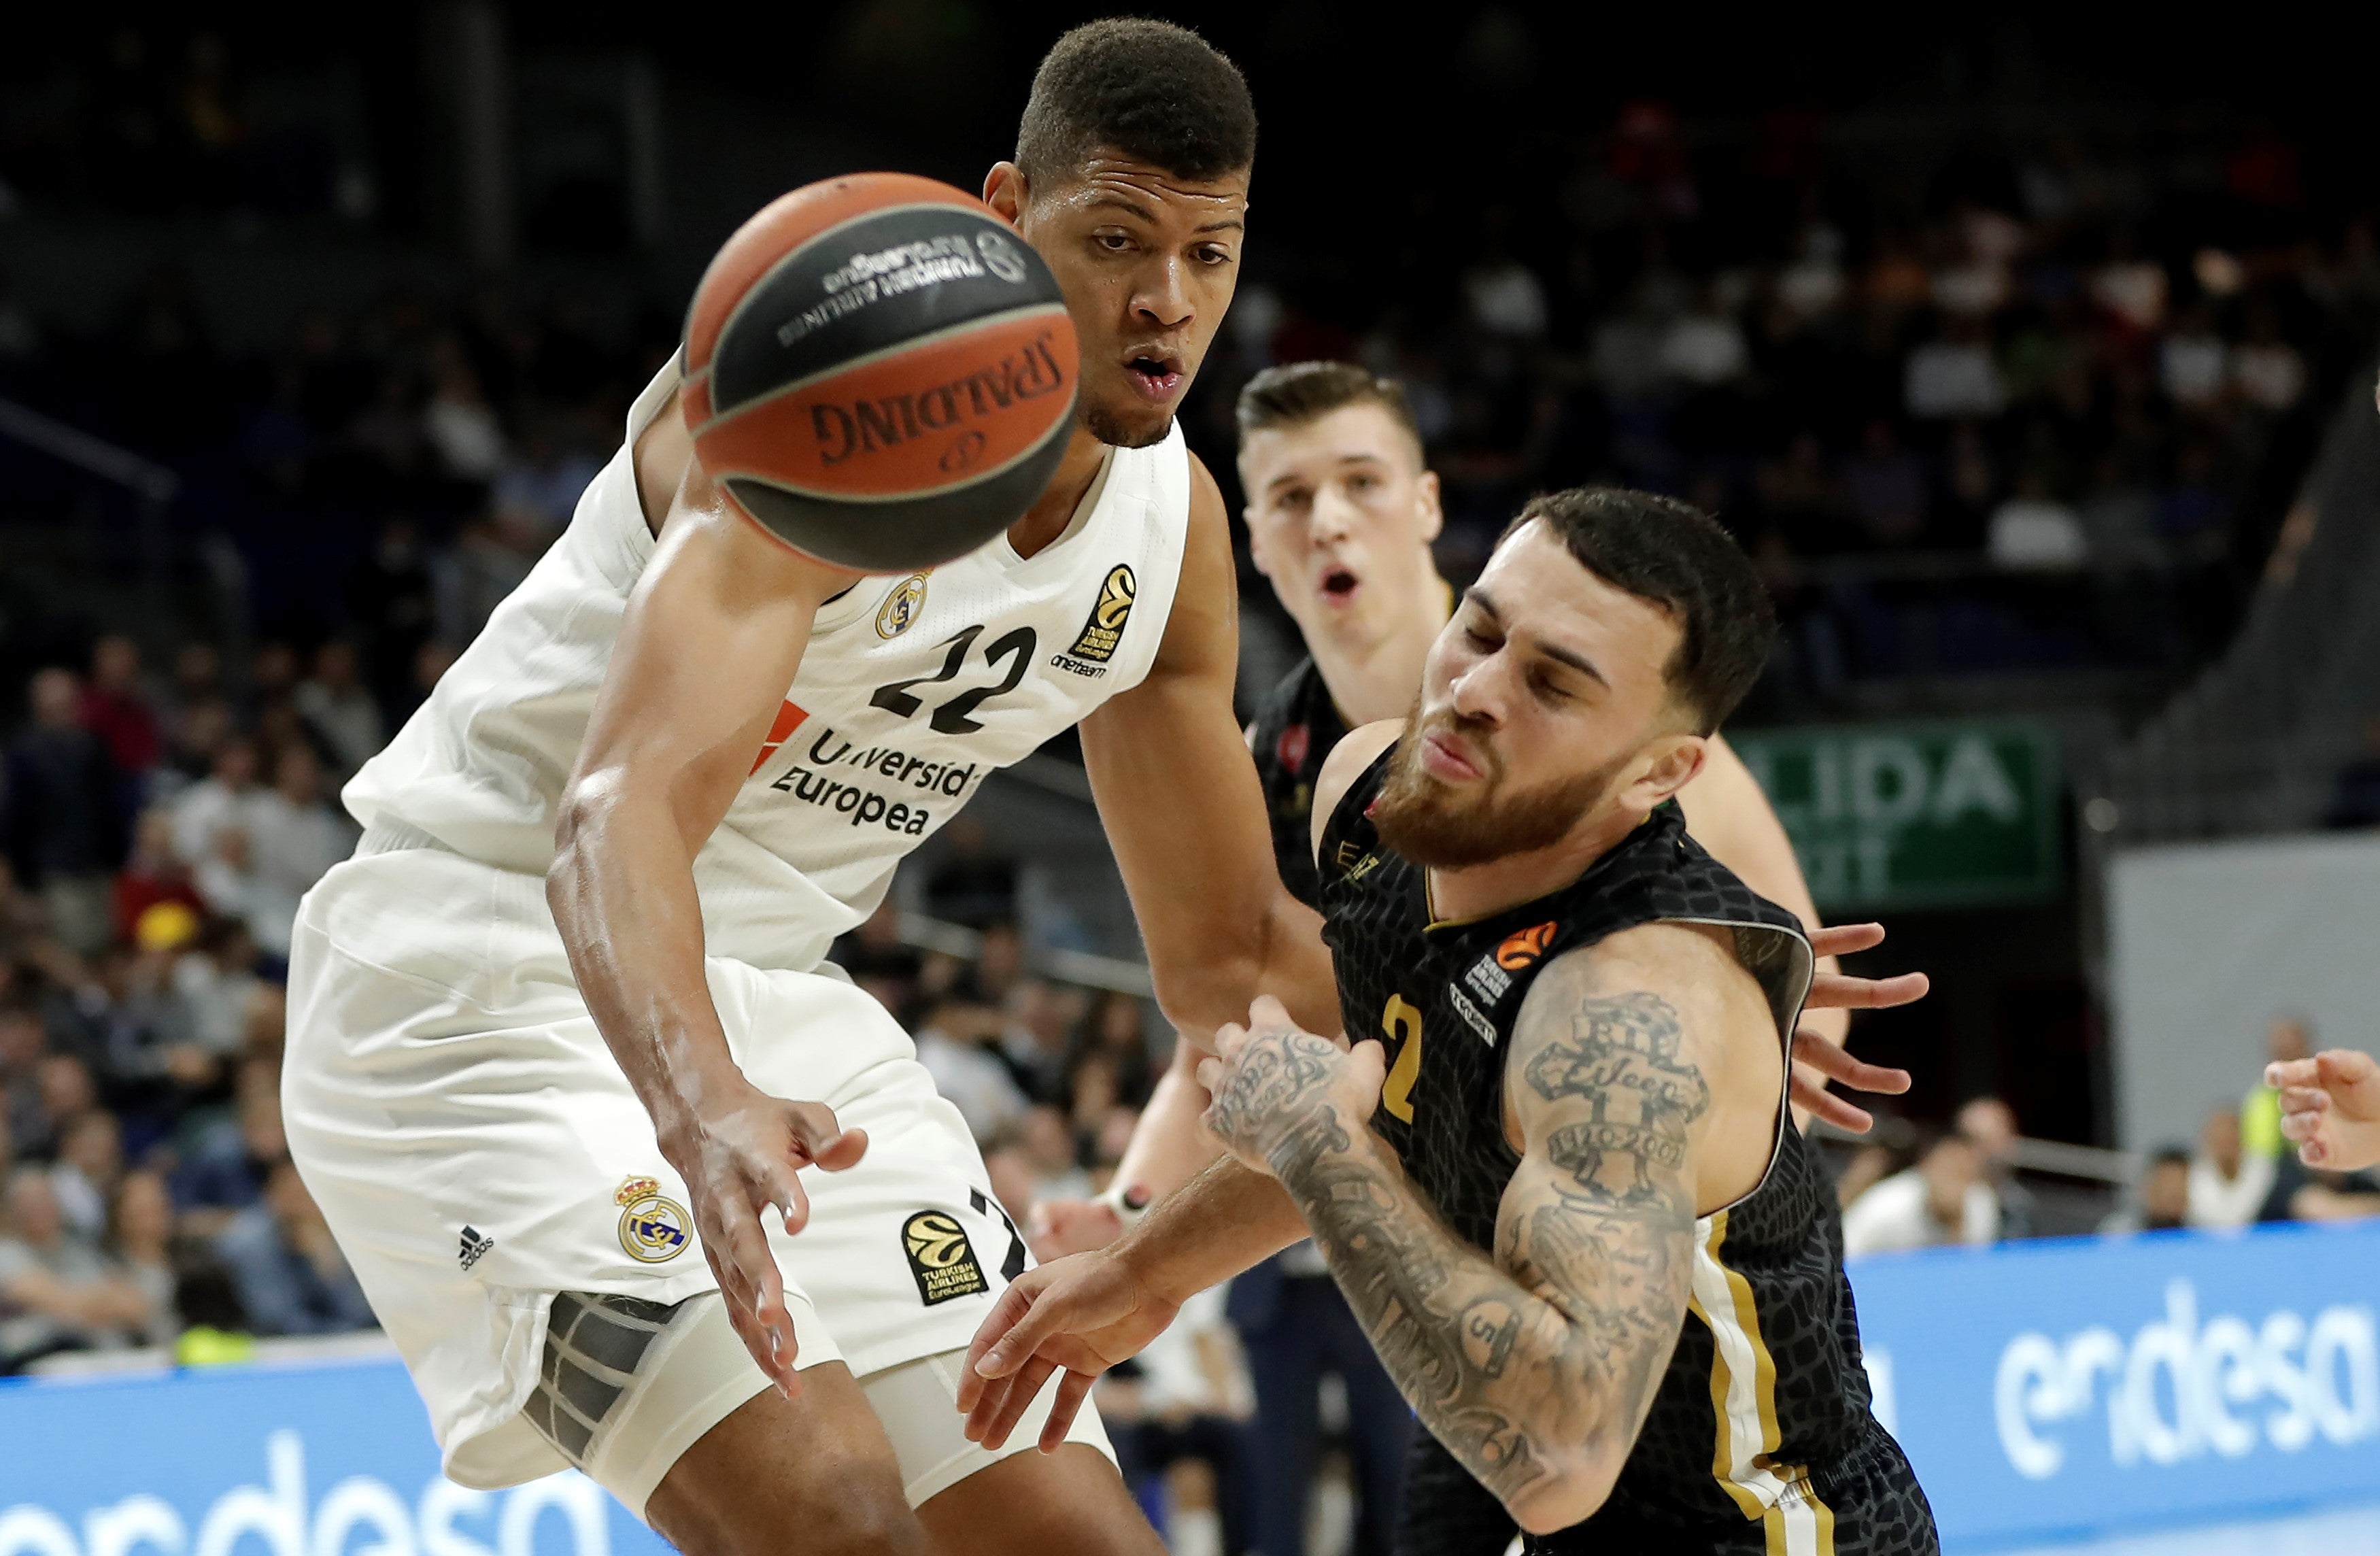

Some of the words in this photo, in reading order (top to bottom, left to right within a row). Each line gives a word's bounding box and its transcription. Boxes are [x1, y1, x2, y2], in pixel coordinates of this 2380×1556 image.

[811, 328, 1064, 467] SPALDING
[869, 624, 1037, 734] 22
[770, 766, 930, 835] Europea
[1382, 994, 1423, 1126] 2
[460, 1237, 494, 1272] adidas
[921, 1262, 974, 1281] TURKISH
[928, 1270, 979, 1291] AIRLINES
[1995, 1278, 2380, 1480] endesa
